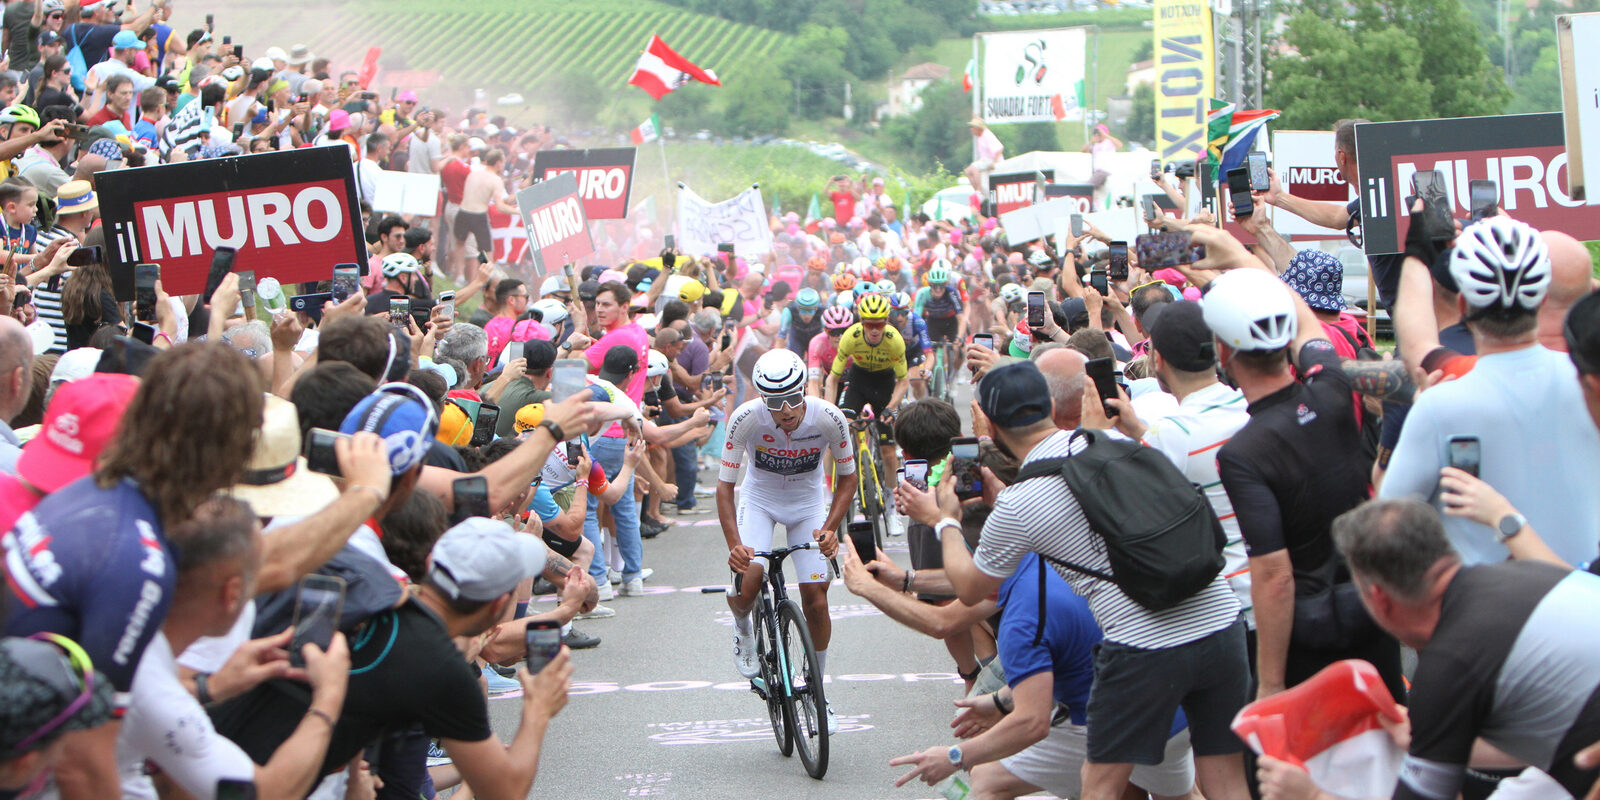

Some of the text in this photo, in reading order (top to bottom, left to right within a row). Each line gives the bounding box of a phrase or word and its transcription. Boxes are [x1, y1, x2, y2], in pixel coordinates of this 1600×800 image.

[987, 97, 1024, 118] SQUADRA
[1369, 177, 1387, 218] il
[115, 186, 343, 263] il MURO
[527, 197, 584, 251] il MURO
[729, 409, 751, 440] CASTELLI
[112, 579, 163, 666] racing
